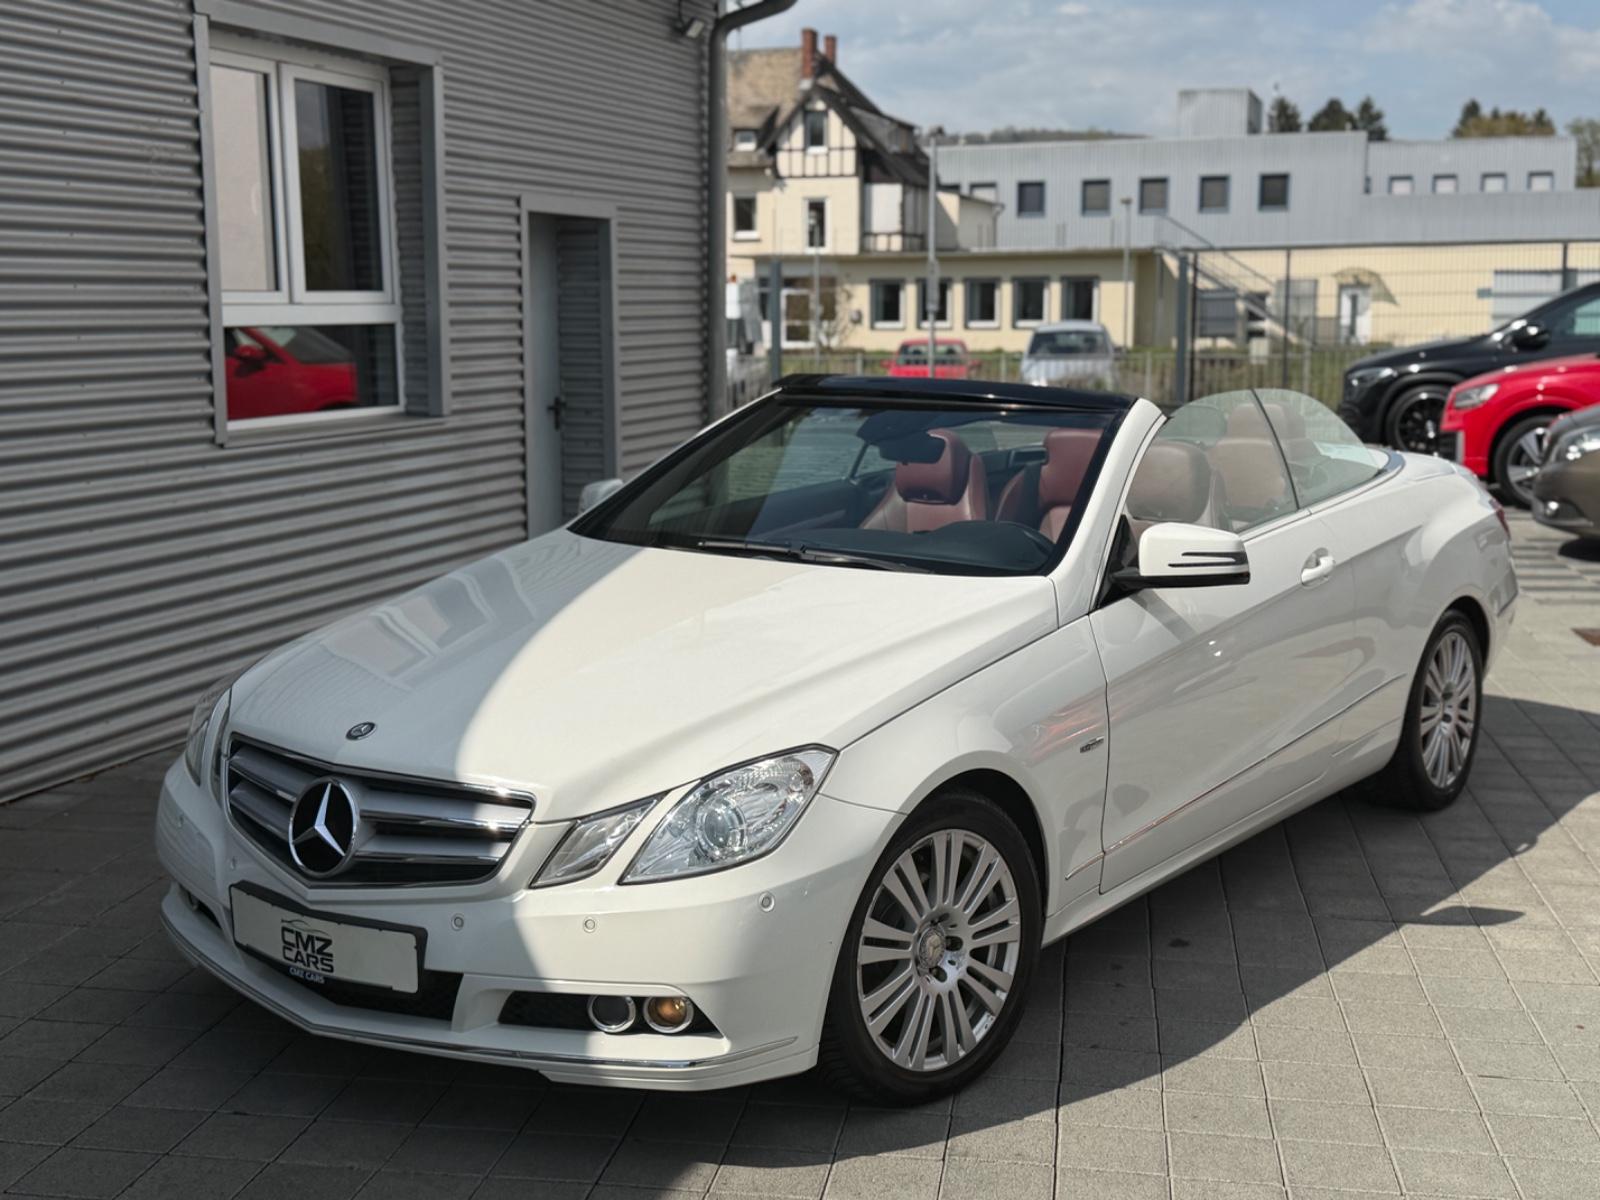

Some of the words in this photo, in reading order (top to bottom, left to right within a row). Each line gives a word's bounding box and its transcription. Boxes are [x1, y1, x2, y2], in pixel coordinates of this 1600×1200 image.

[281, 927, 333, 957] CMZ
[282, 945, 334, 973] CARS
[305, 971, 325, 984] CARS
